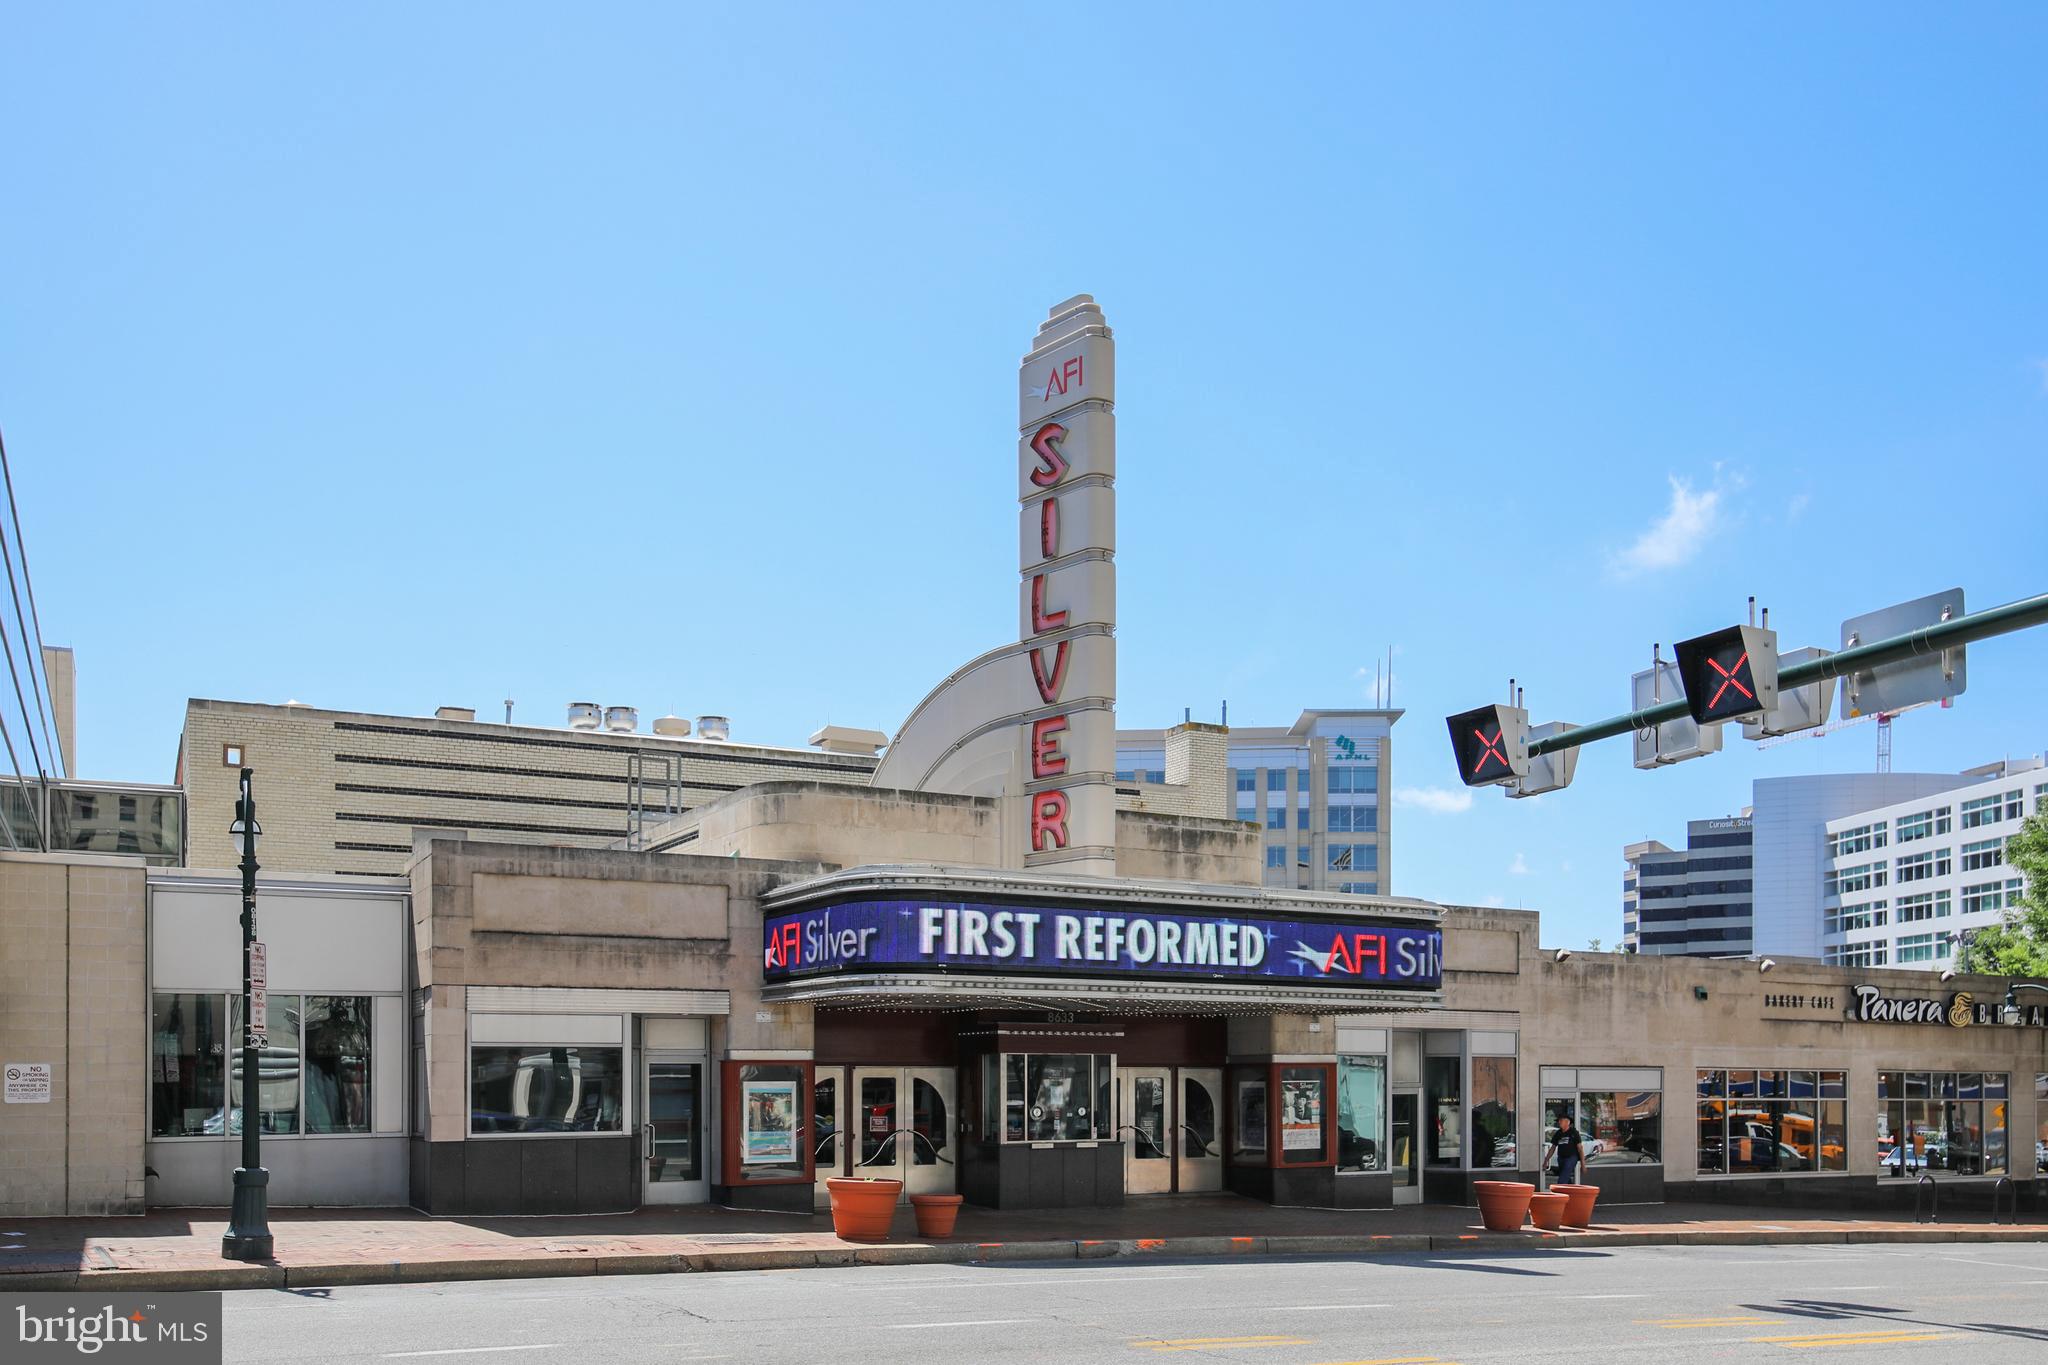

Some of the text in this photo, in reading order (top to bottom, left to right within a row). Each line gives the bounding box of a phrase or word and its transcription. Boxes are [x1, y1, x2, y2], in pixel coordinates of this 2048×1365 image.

[1044, 355, 1083, 402] AFI
[1030, 423, 1072, 852] SILVER
[767, 922, 801, 969] AFI
[805, 910, 878, 964] Silver
[918, 907, 1041, 959] FIRST
[1054, 914, 1266, 967] REFORMED
[1323, 931, 1387, 975] AFI
[1047, 1012, 1074, 1023] 8633
[1765, 994, 1834, 1009] BAKERY CAFE
[1852, 985, 1944, 1022] Panera
